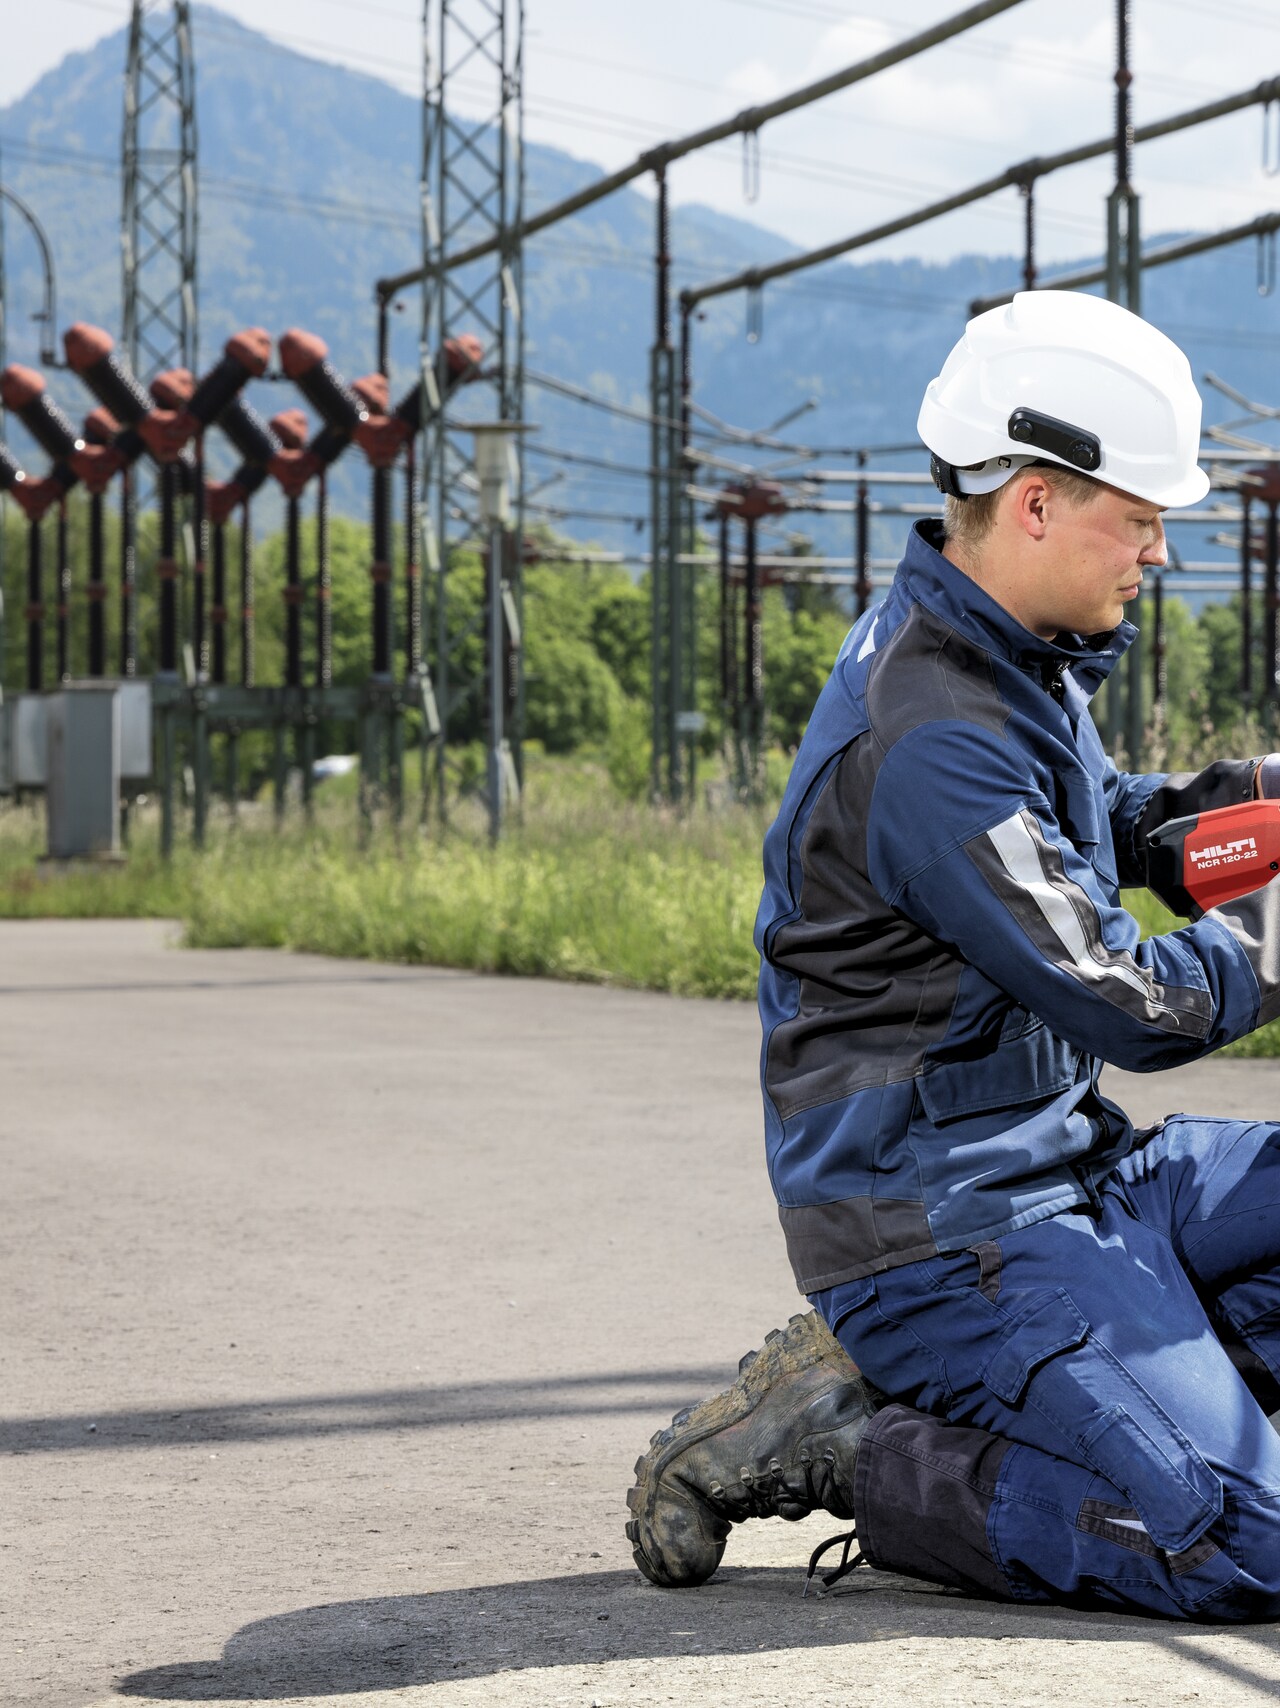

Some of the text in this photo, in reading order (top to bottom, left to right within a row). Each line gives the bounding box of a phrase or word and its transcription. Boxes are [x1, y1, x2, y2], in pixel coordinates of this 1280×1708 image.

[1190, 837, 1256, 862] HILTI
[1197, 850, 1258, 870] NCR 120-22
